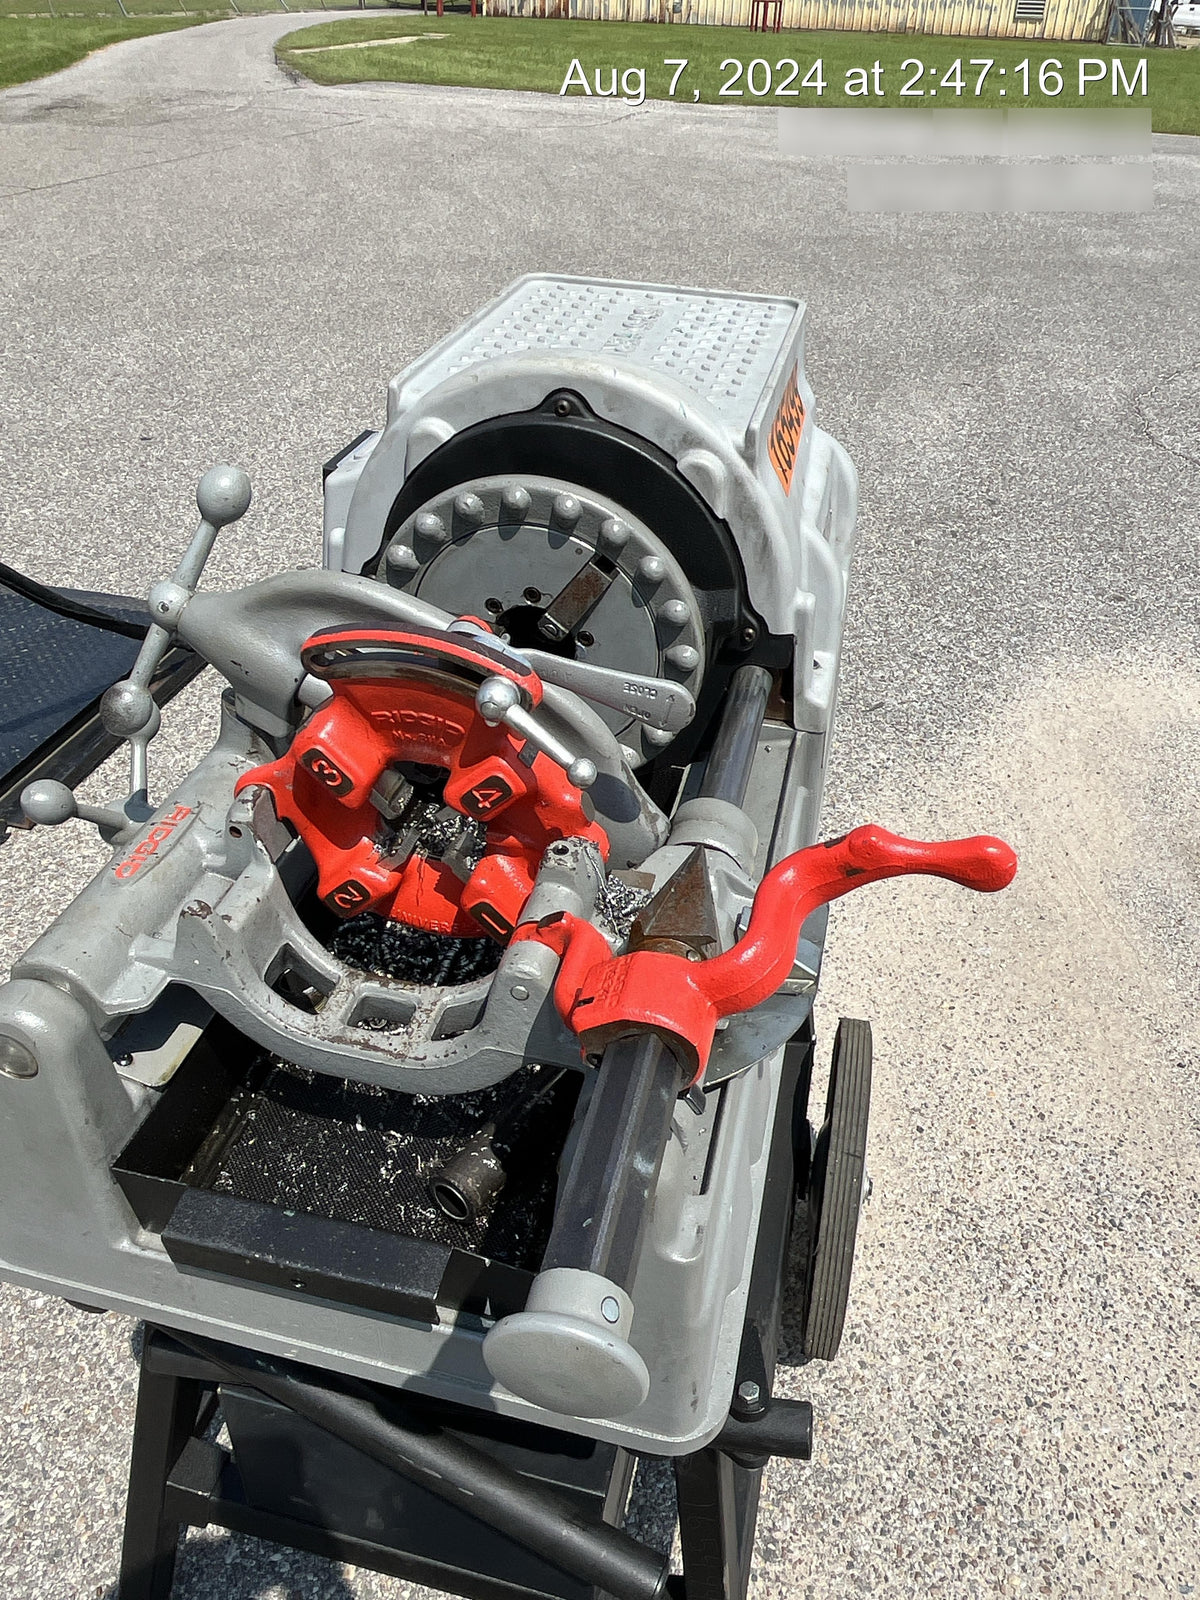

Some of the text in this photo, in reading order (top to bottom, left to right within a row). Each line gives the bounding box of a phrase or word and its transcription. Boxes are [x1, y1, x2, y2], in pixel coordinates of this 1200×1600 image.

[623, 681, 658, 700] CLOSE
[371, 709, 466, 736] RIDGID
[622, 703, 651, 721] OPEN
[310, 758, 343, 788] 3
[470, 788, 503, 809] 4
[114, 805, 192, 879] RIDGID
[333, 885, 364, 908] 2
[480, 911, 508, 935] 1
